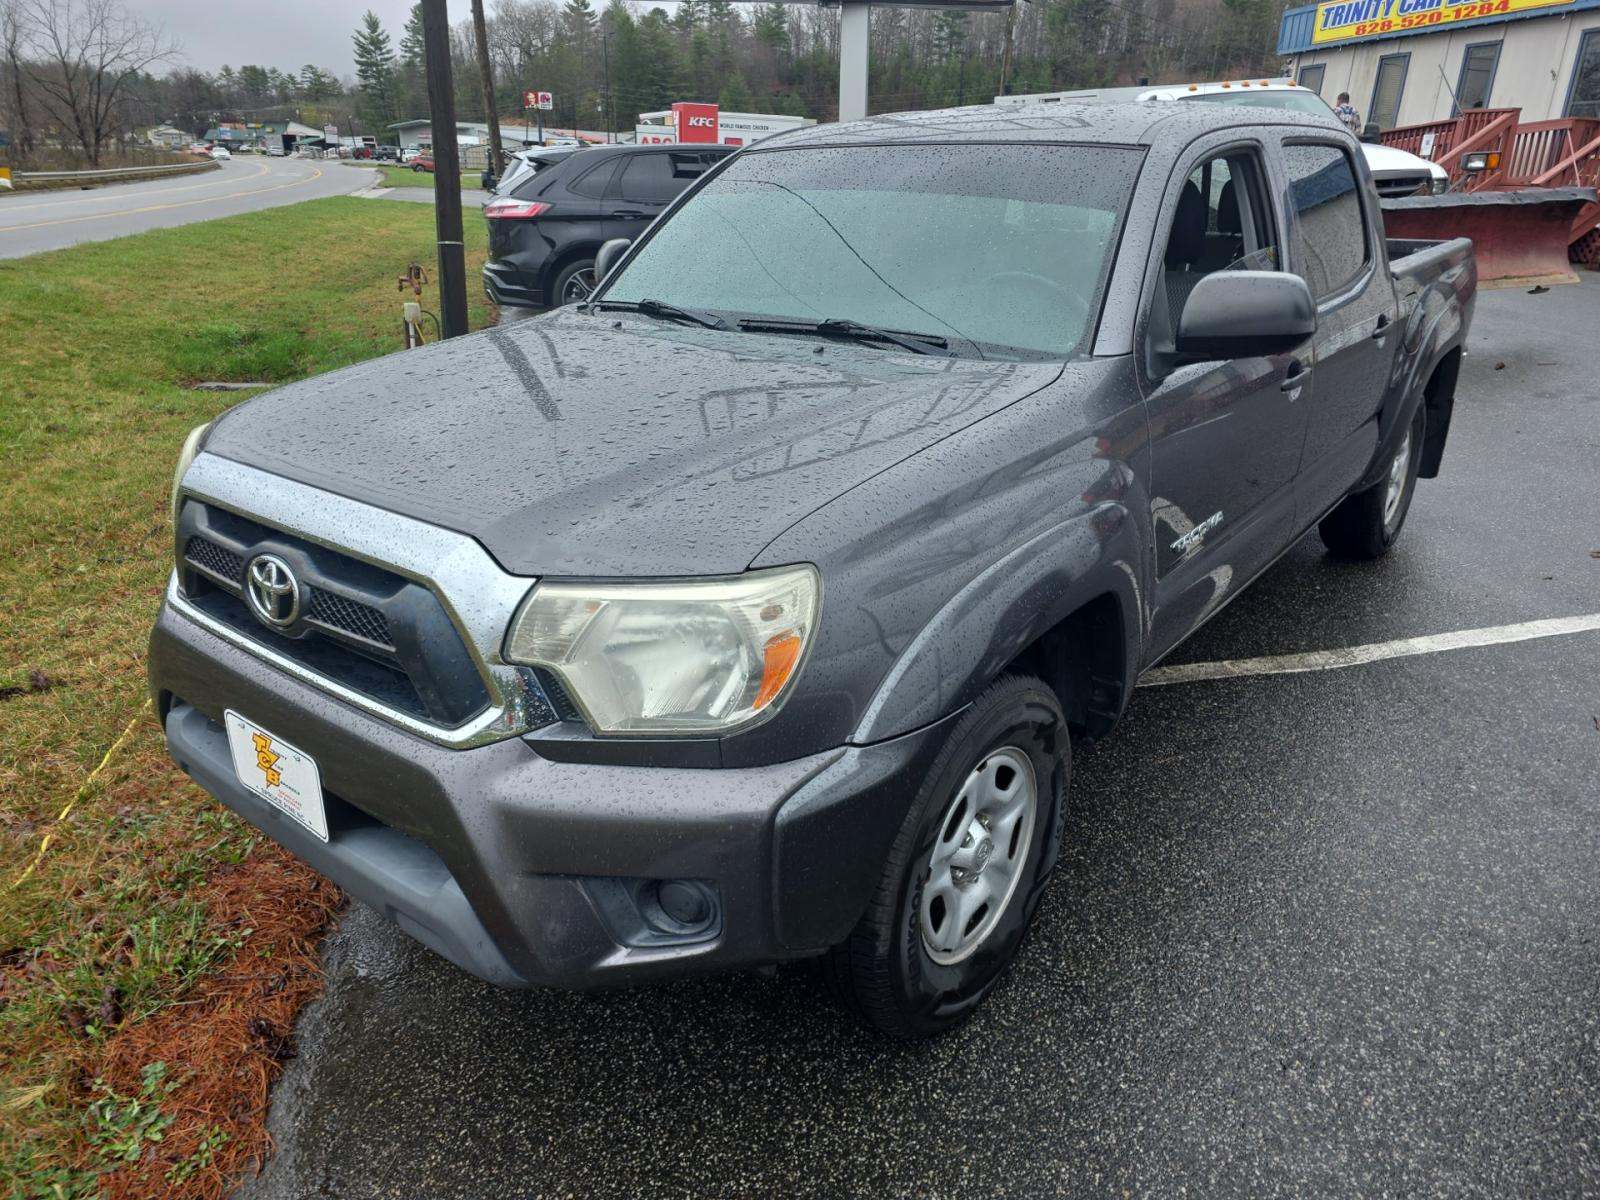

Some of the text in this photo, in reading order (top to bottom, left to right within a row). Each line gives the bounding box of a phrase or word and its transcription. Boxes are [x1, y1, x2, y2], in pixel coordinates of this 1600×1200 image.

[1322, 0, 1396, 29] TRINITY
[1355, 0, 1510, 36] 828-520-1284
[688, 116, 714, 127] KFC
